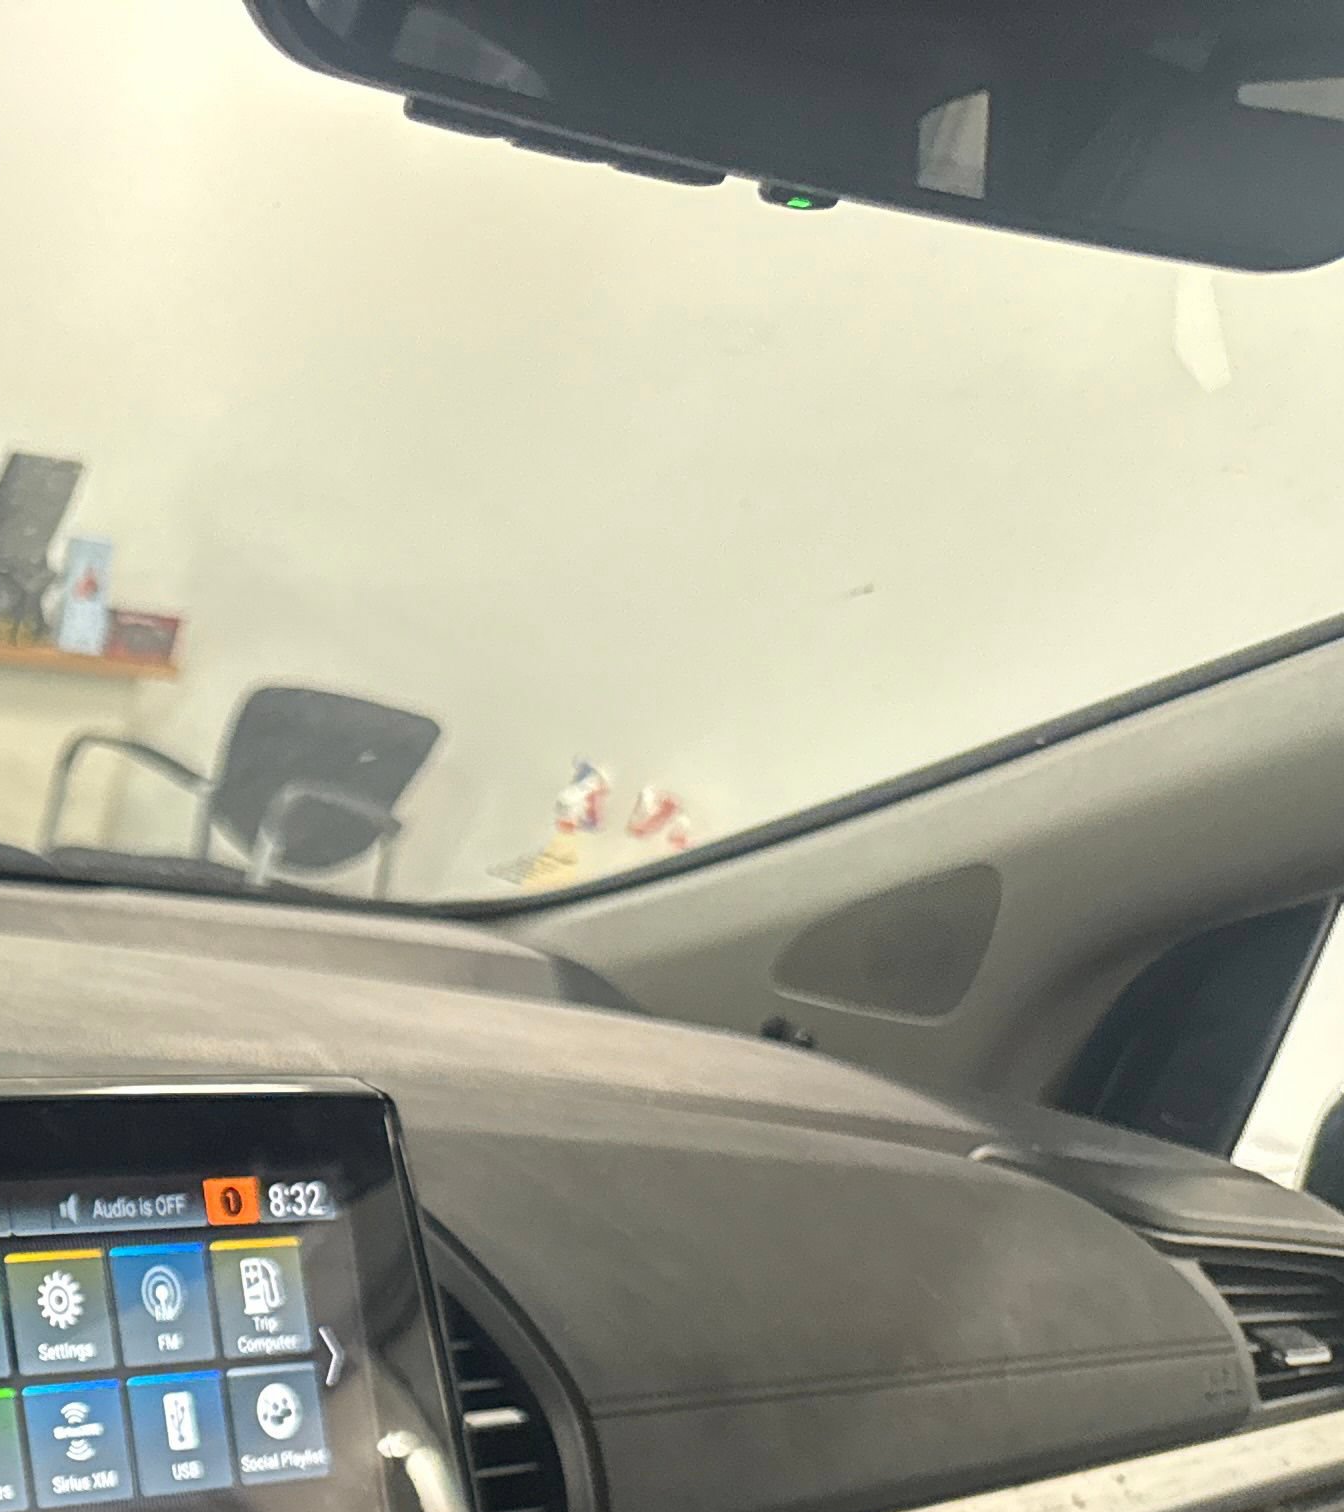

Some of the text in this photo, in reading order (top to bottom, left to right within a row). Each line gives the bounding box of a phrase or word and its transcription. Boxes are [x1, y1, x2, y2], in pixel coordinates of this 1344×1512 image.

[92, 1194, 187, 1219] Audio is OFF
[268, 1182, 326, 1217] 8:32
[252, 1317, 278, 1333] Trip
[38, 1342, 95, 1362] Settings
[158, 1334, 182, 1351] FM
[237, 1336, 299, 1354] Computer
[241, 1449, 329, 1472] Social Playlist
[171, 1461, 201, 1481] USB
[52, 1470, 119, 1494] Sirius XM
